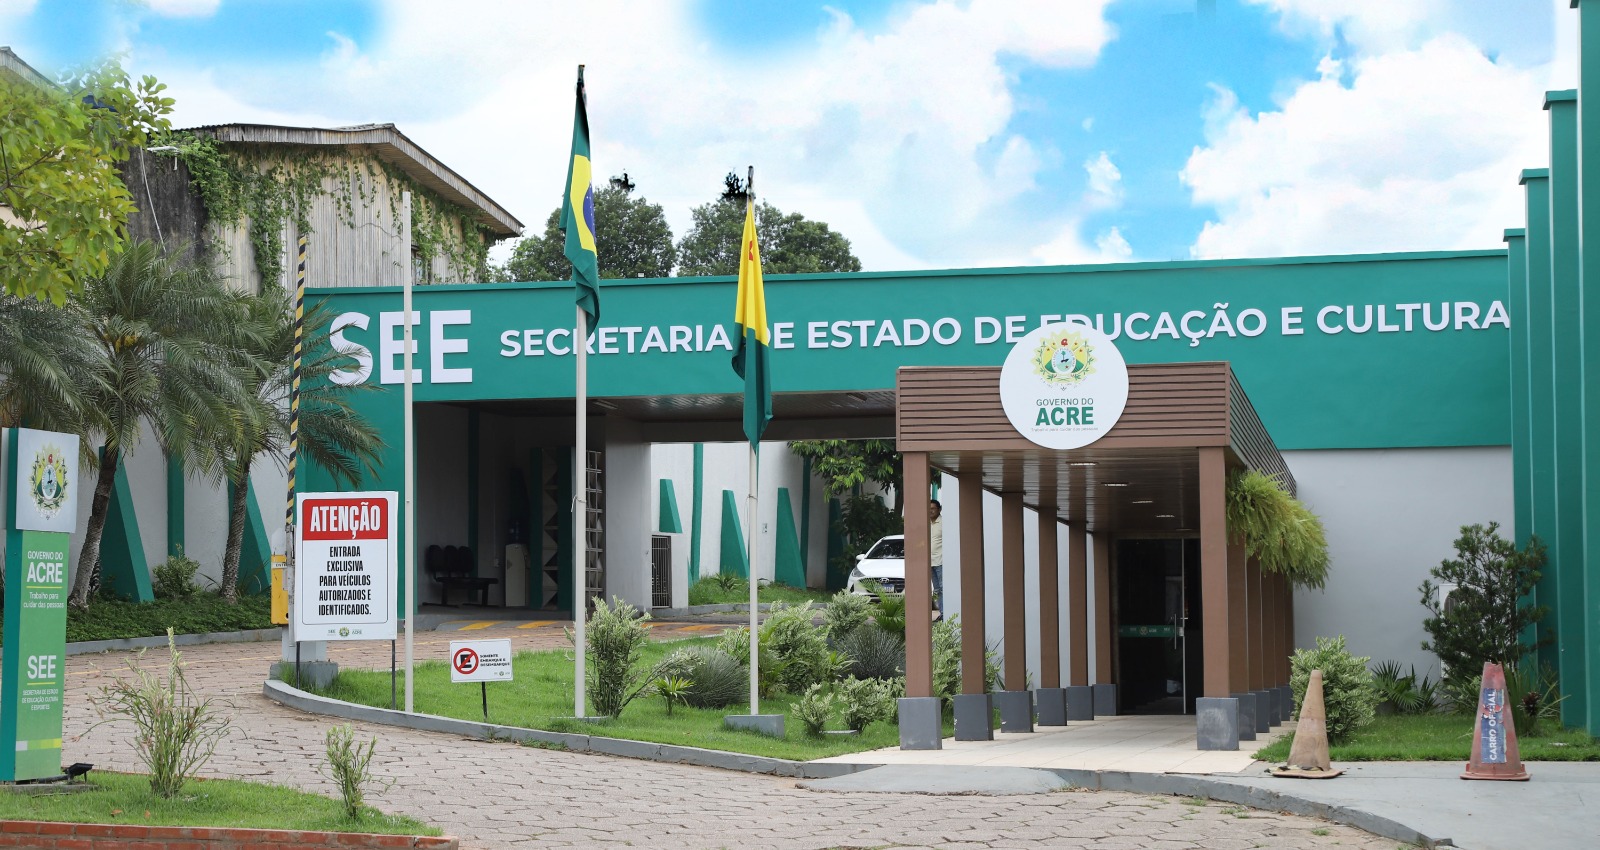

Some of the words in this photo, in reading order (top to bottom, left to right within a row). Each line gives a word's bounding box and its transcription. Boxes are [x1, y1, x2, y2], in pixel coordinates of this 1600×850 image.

[766, 322, 795, 349] E
[808, 317, 962, 348] ESTADO
[974, 314, 1027, 344] DE
[1040, 302, 1267, 347] UCAÇÃO
[1281, 306, 1305, 335] E
[1317, 300, 1511, 334] CULTURA
[328, 310, 473, 385] SEE
[1036, 398, 1079, 406] GOVERNO
[1081, 397, 1094, 405] DO
[1035, 406, 1094, 426] ACRE
[310, 501, 381, 539] ATENÇÃO
[27, 550, 54, 560] GOVERNO
[55, 551, 63, 560] DO
[329, 545, 361, 557] ENTRADA
[26, 561, 64, 583] ACRE
[326, 560, 364, 572] EXCLUSIVA
[319, 575, 338, 587] PARA
[338, 572, 371, 587] VEÍCULOS
[29, 591, 48, 600] Trabalho
[319, 589, 366, 602] AUTORIZADOS
[367, 589, 372, 601] E
[318, 604, 372, 616] IDENTIFICADOS.
[27, 655, 57, 679] SEE
[1489, 729, 1497, 760] CARRO
